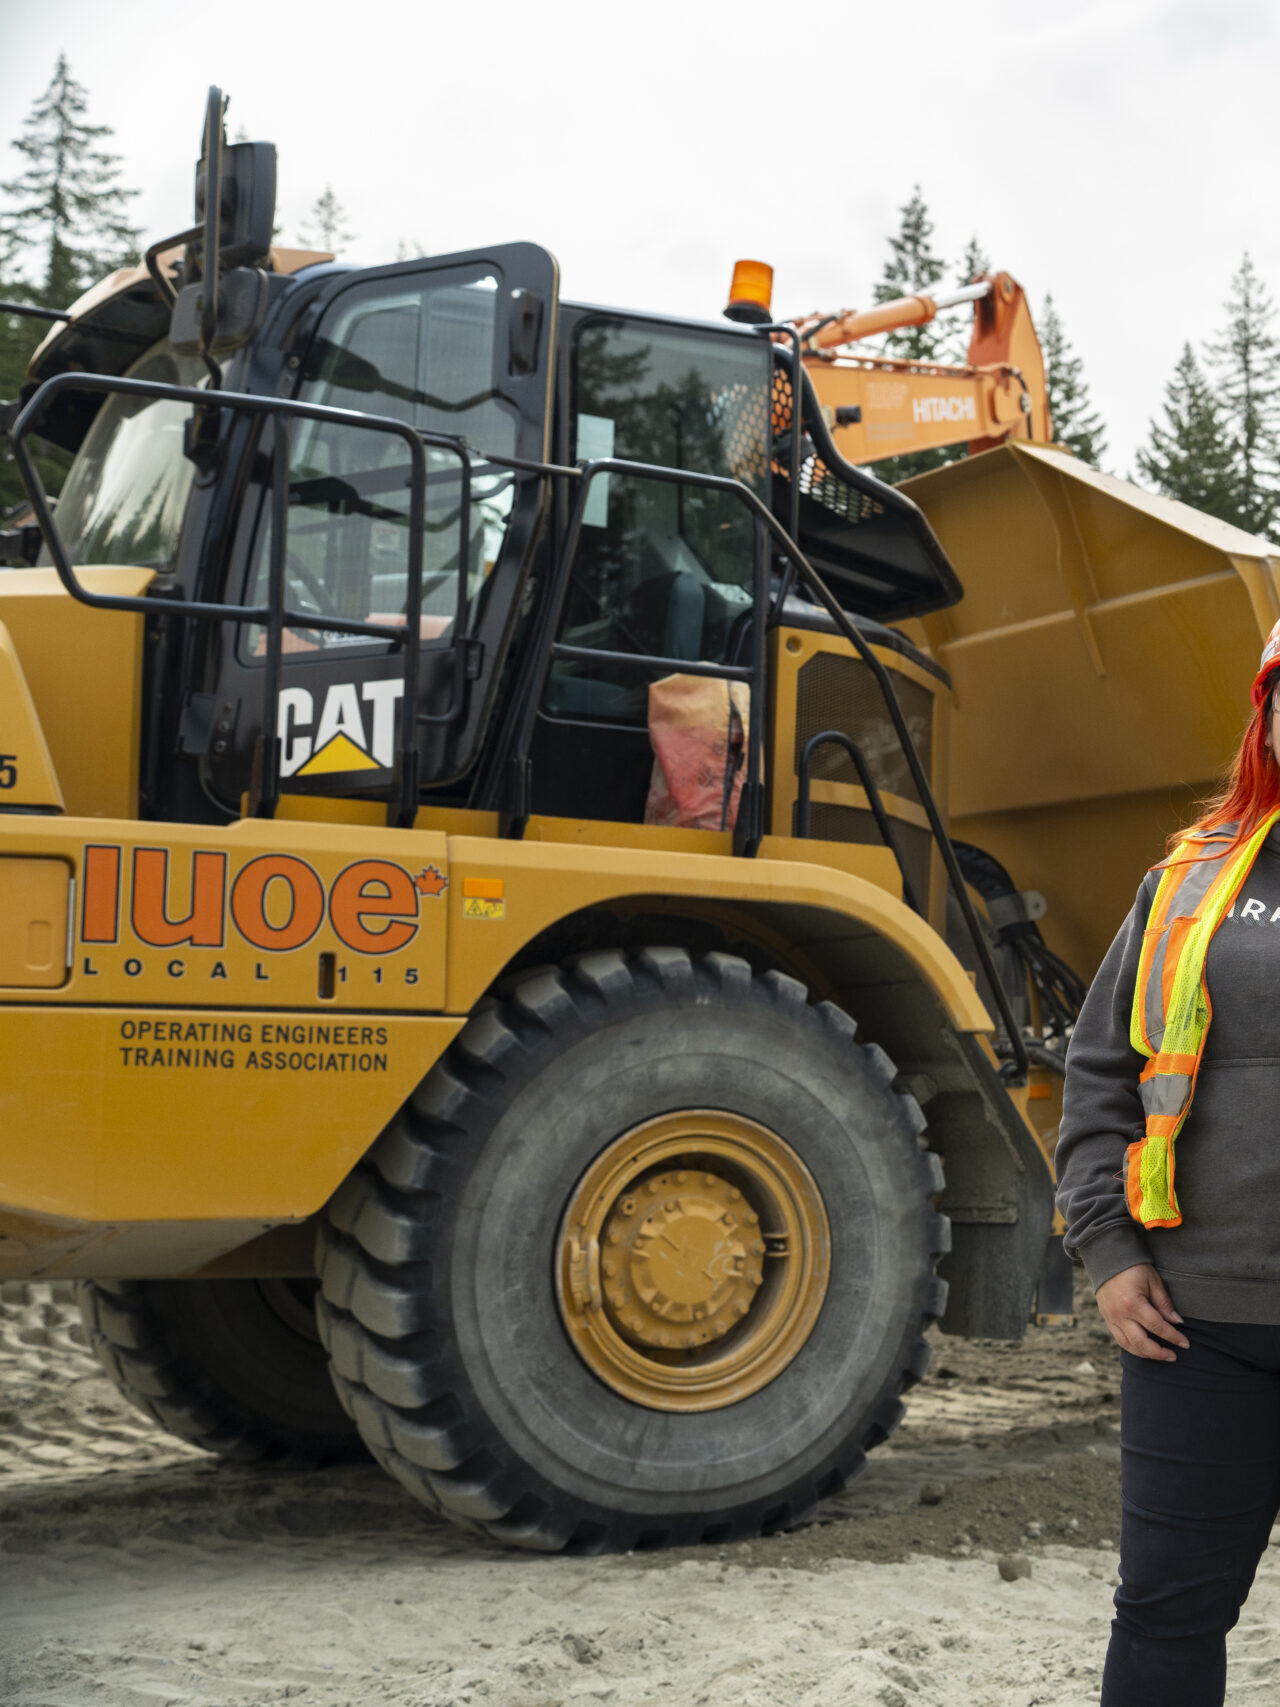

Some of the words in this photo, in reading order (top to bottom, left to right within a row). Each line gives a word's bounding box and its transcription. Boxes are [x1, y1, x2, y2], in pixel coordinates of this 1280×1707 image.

[912, 396, 976, 423] HITACHI
[277, 678, 405, 778] CAT
[83, 957, 270, 981] LOCAL
[337, 965, 419, 984] 115
[120, 1020, 252, 1043] OPERATING
[261, 1024, 389, 1046] ENGINEERS
[119, 1047, 236, 1068] TRAINING
[245, 1050, 389, 1072] ASSOCIATION
